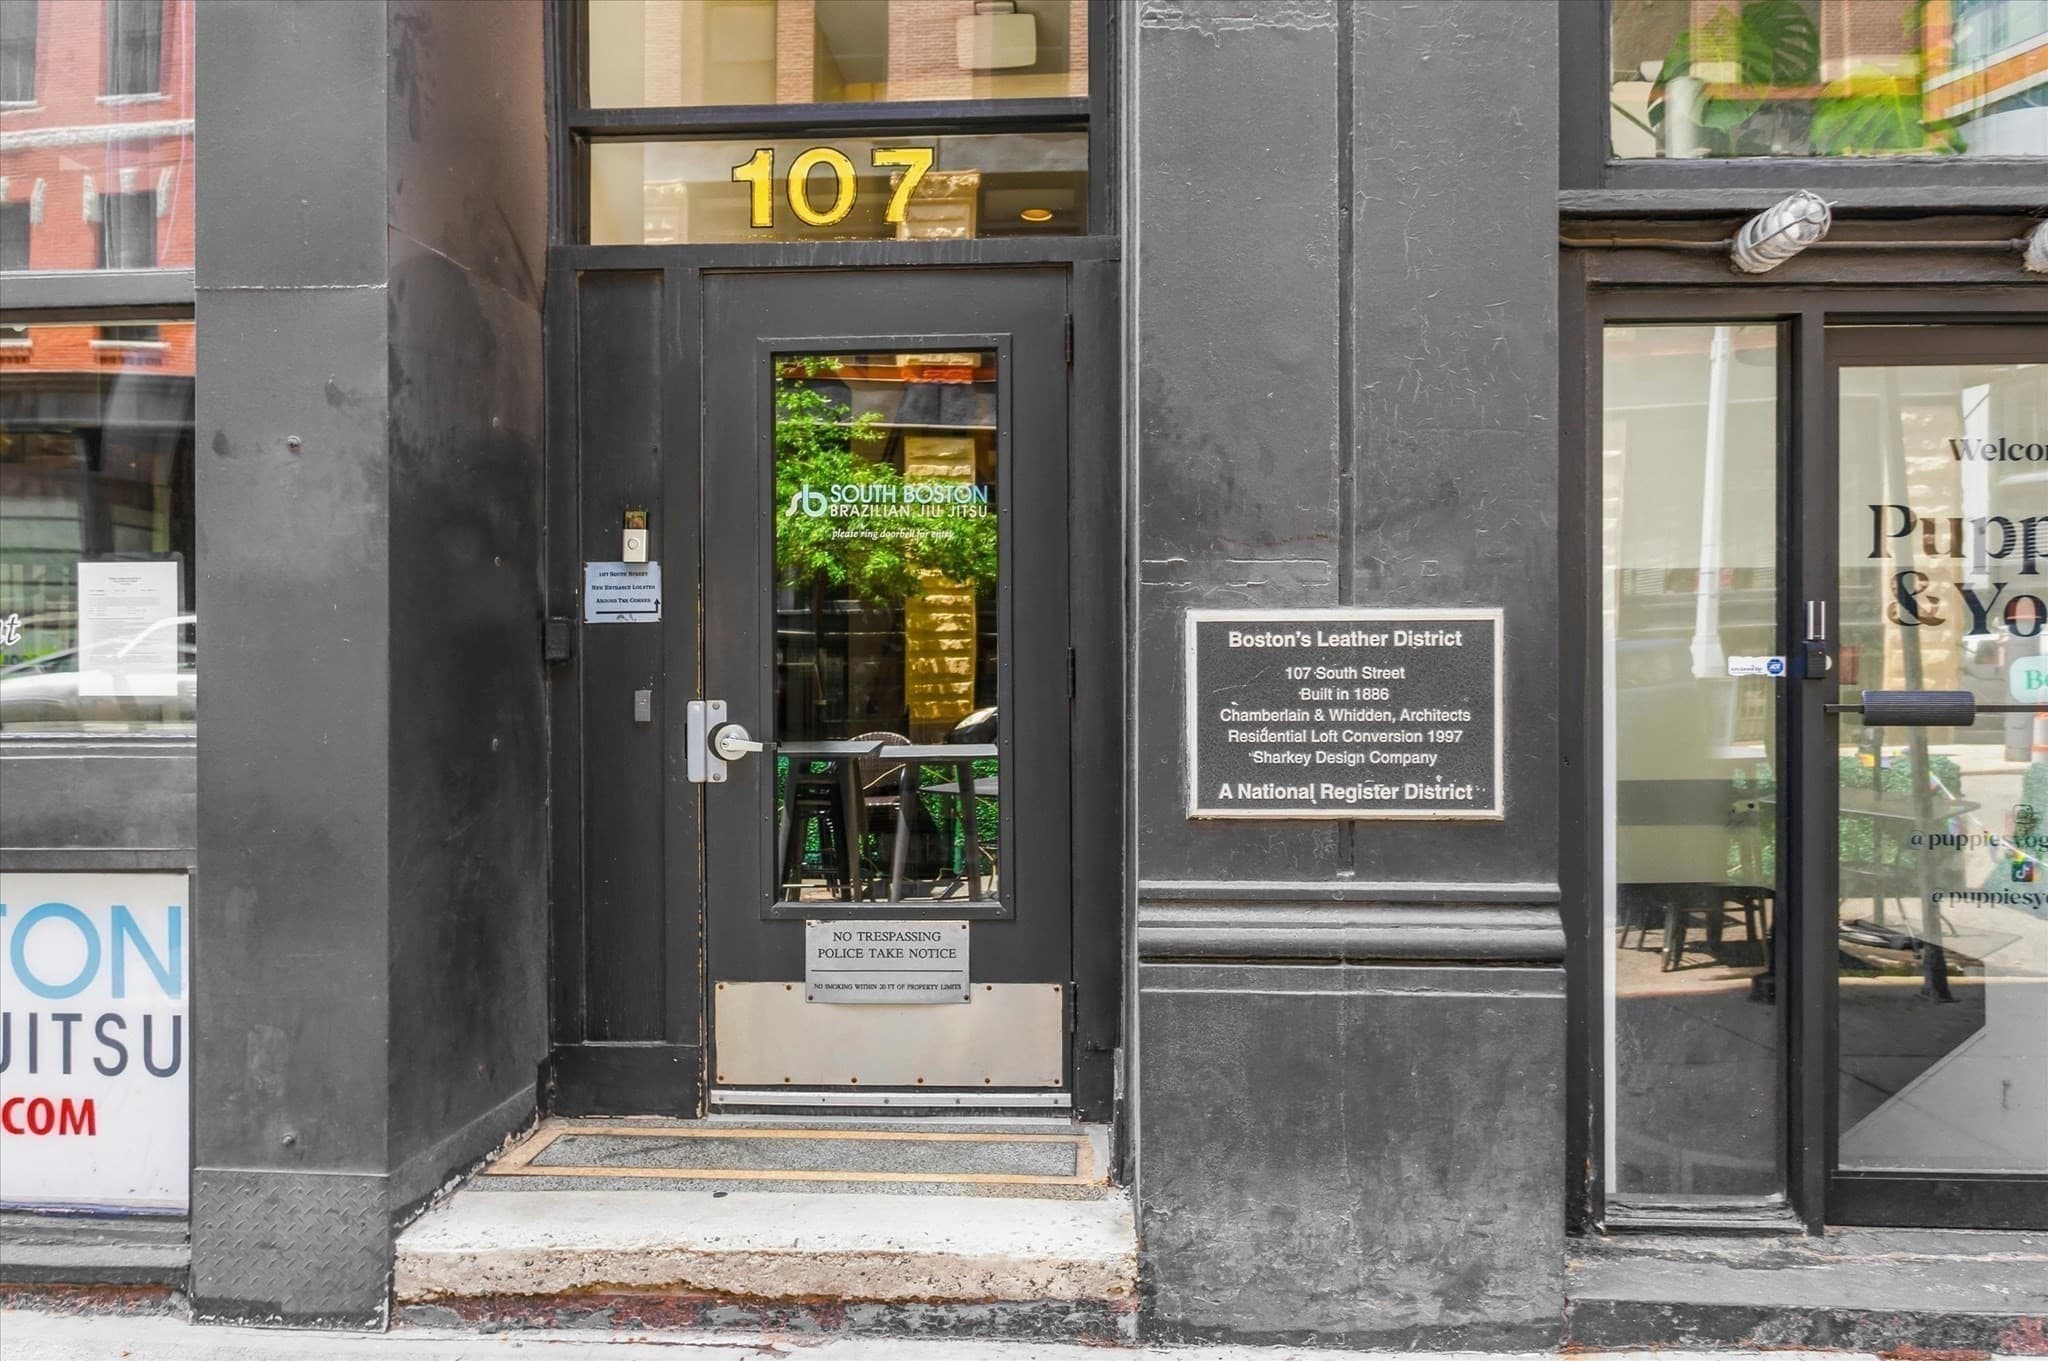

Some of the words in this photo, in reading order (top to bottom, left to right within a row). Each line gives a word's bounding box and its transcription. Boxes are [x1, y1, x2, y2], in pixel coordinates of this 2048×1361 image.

[732, 147, 935, 228] 107
[830, 484, 896, 503] SOUTH
[903, 484, 988, 504] BOSTON
[830, 504, 910, 517] BRAZILIAN
[917, 504, 941, 517] JIU
[948, 504, 988, 517] JITSU
[832, 529, 859, 540] please
[860, 529, 878, 540] ring
[880, 528, 915, 539] doorbell
[1887, 571, 1946, 627] &
[1228, 630, 1312, 648] Boston's
[1317, 630, 1389, 648] Leather
[1394, 630, 1463, 648] District
[1285, 667, 1312, 680] 107
[1316, 667, 1358, 680] South
[1362, 667, 1406, 680] Street
[1301, 687, 1333, 701] Built
[1336, 687, 1350, 701] in
[1354, 687, 1390, 701] 1886
[1219, 708, 1310, 722] Chamberlain
[1313, 709, 1325, 722] &
[1329, 708, 1396, 724] Whidden,
[1400, 708, 1471, 722] Architects
[1228, 729, 1307, 744] Residential
[1311, 729, 1339, 744] Loft
[1342, 729, 1423, 744] Conversion
[1427, 729, 1464, 744] 1997
[1252, 750, 1312, 767] Sharkey
[1315, 750, 1366, 767] Design
[1369, 750, 1438, 767] Company
[1218, 784, 1233, 800] A
[1238, 783, 1313, 800] National
[1321, 783, 1400, 804] Register
[1404, 783, 1473, 801] District
[1928, 887, 2048, 910] @puppiesy
[832, 931, 853, 942] NO
[857, 931, 942, 942] TRESPASSING
[0, 902, 182, 1000] ON
[818, 948, 864, 959] POLICE
[868, 948, 905, 959] TAKE
[909, 948, 957, 959] NOTICE
